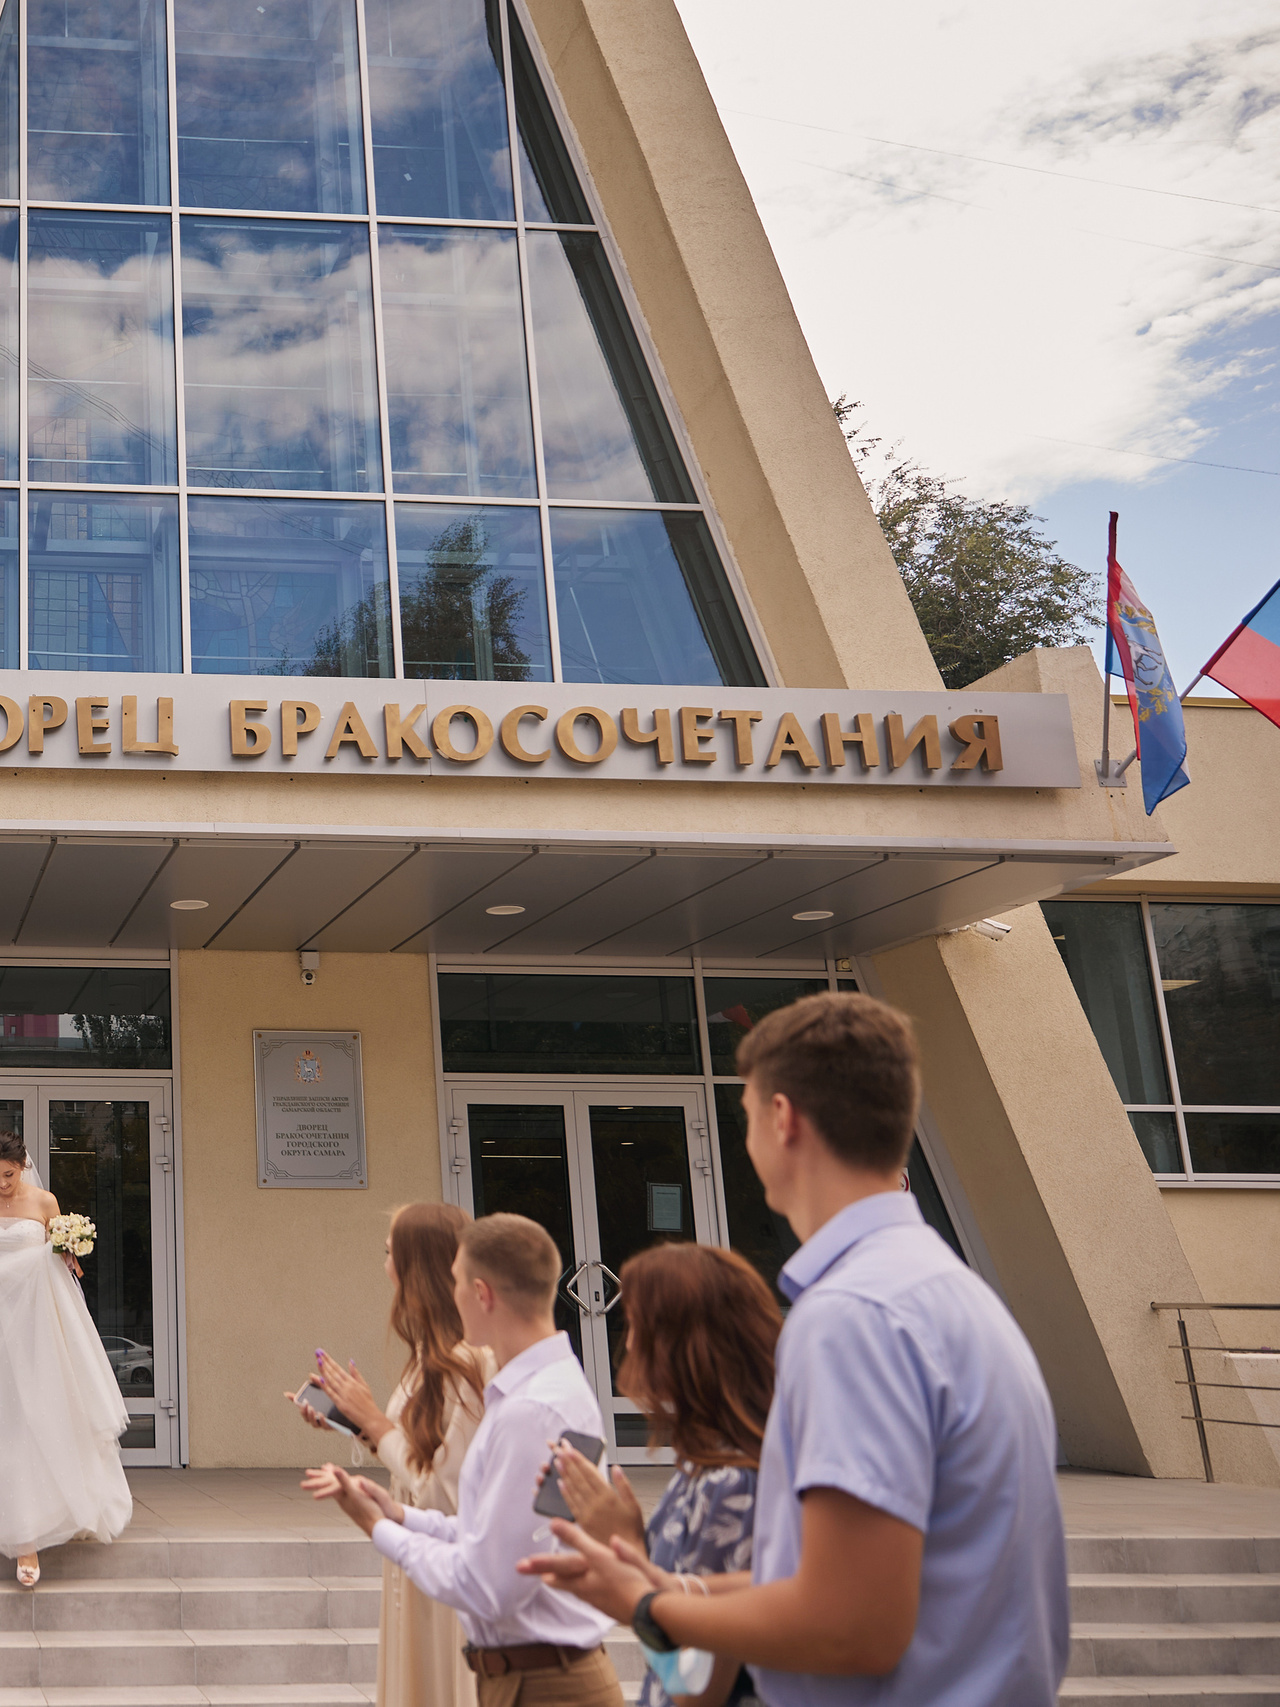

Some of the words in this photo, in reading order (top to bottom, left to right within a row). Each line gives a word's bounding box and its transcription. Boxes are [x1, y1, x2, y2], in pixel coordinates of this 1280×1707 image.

[227, 699, 1005, 773] БРАКОСОЧЕТАНИЯ
[275, 1132, 350, 1140] БРАКОСОЧЕТАНИЯ
[313, 1149, 346, 1157] САМАРА
